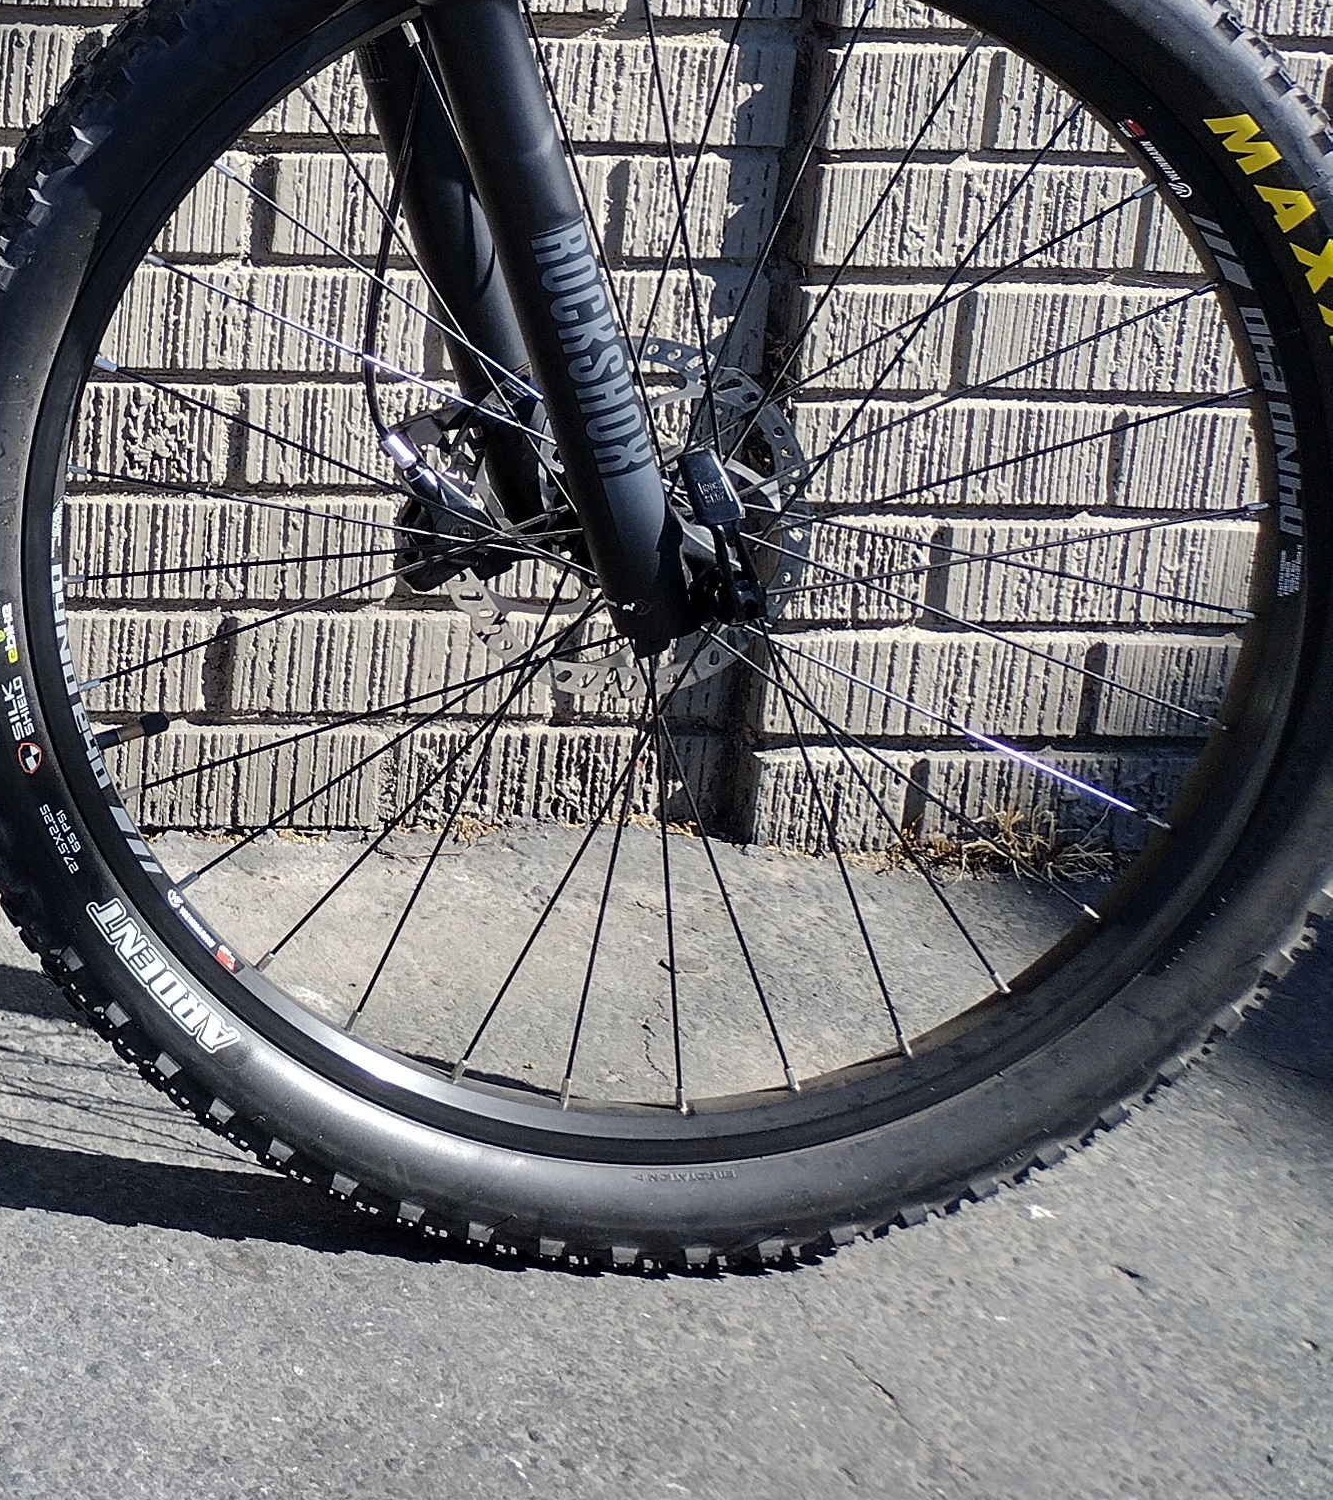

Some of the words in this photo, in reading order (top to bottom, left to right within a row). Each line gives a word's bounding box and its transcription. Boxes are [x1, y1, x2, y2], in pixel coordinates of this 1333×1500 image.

[531, 223, 657, 479] ROCKSHOX
[1, 680, 25, 742] SILK
[16, 675, 36, 736] SHIELD
[39, 802, 81, 875] 27.5X2.25
[54, 808, 74, 833] PSI
[65, 831, 83, 854] 65
[87, 897, 241, 1054] ARDENT
